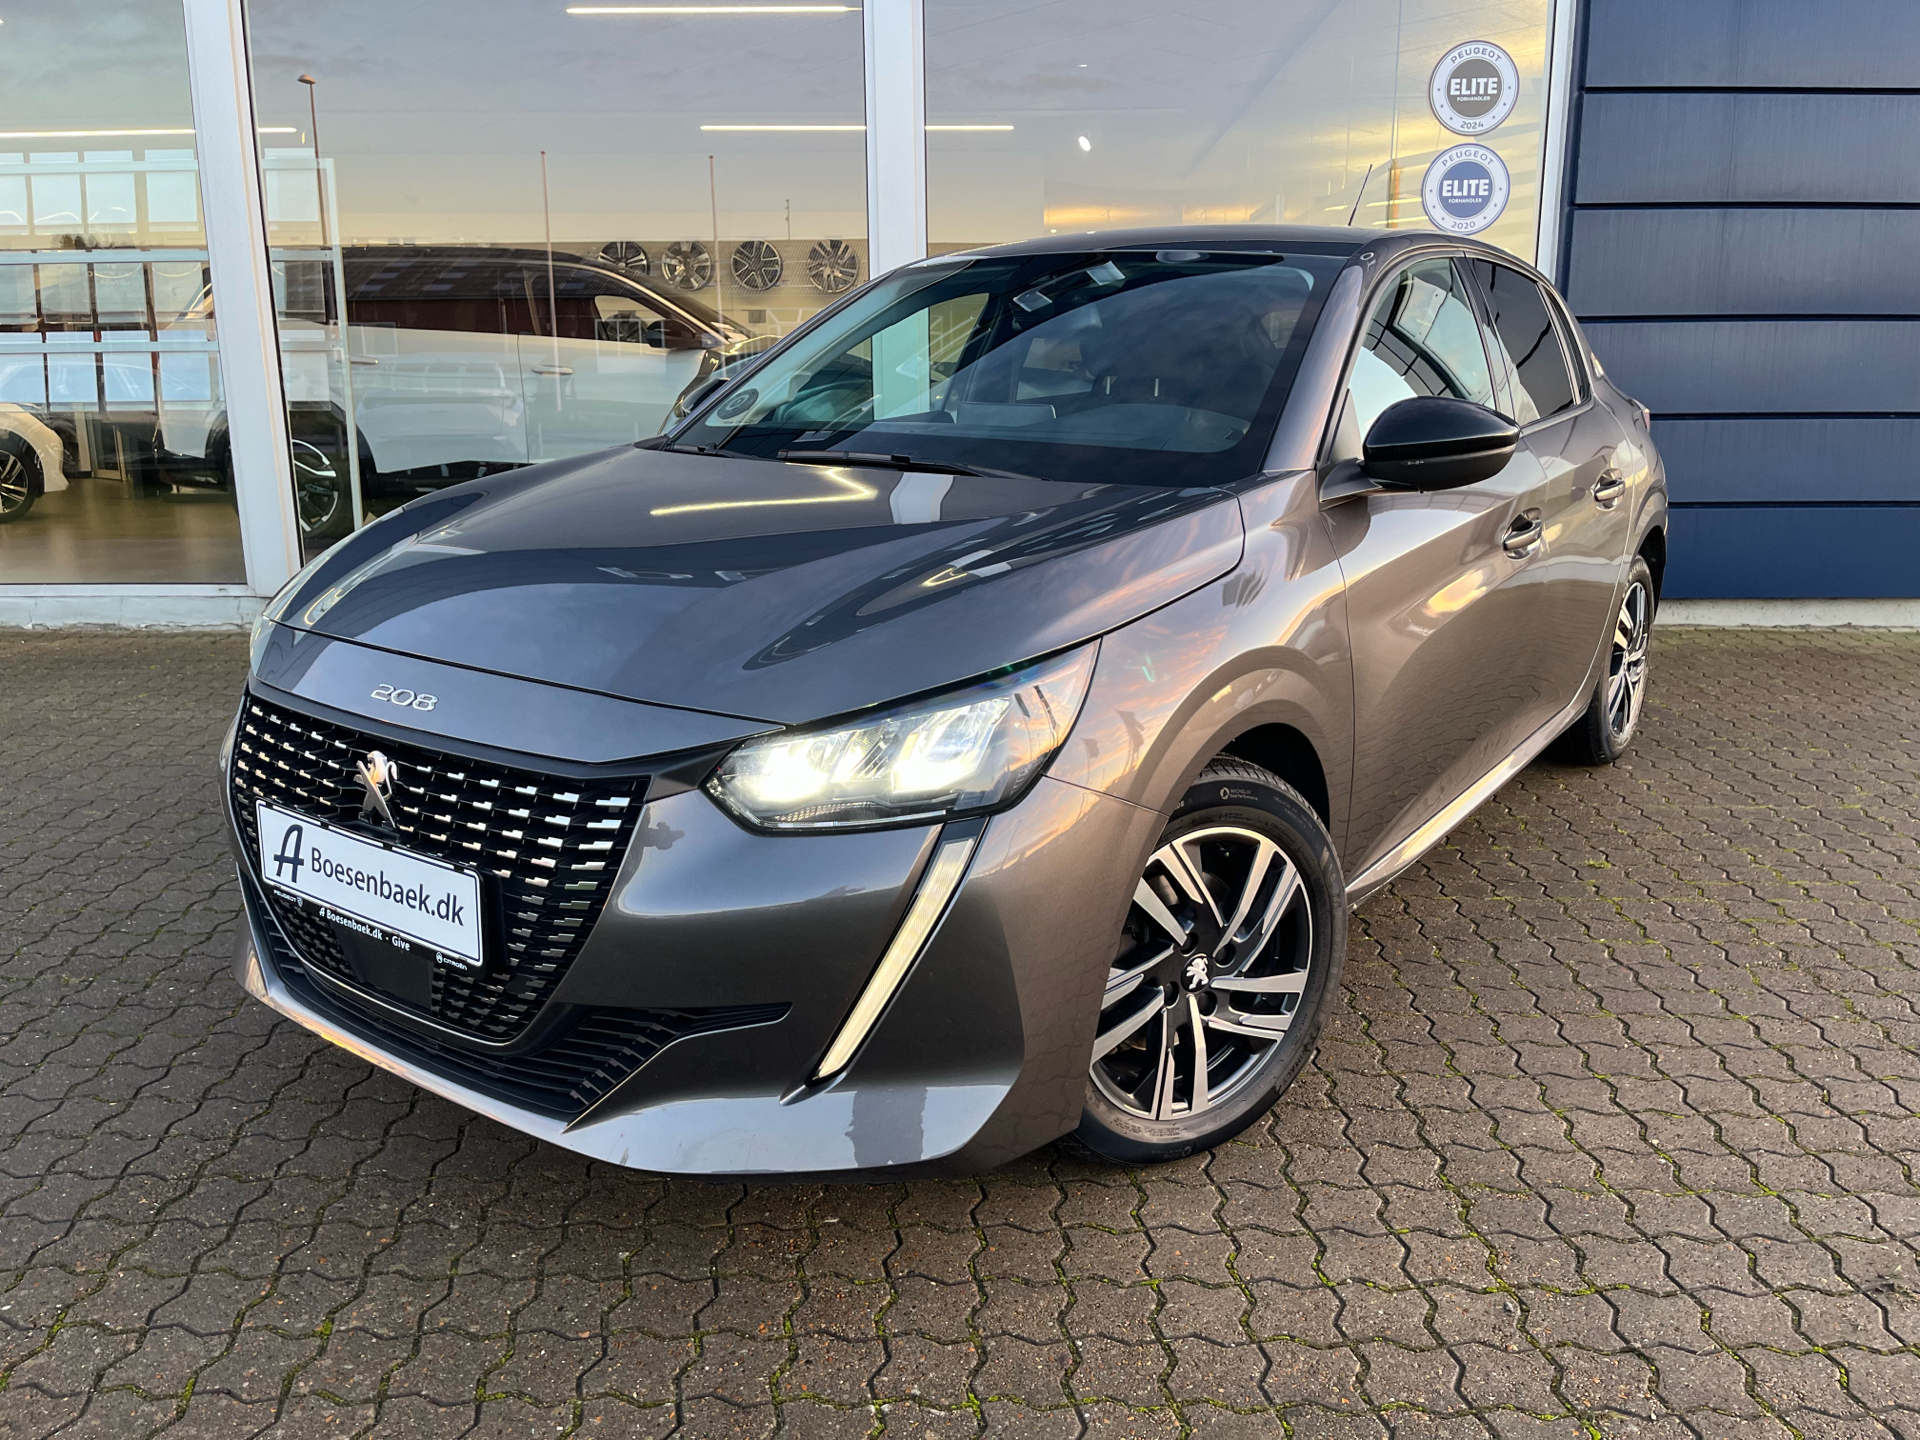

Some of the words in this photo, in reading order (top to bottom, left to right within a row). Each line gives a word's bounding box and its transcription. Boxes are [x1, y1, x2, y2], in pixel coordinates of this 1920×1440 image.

[1450, 47, 1502, 64] PEUGEOT
[1450, 77, 1498, 95] ELITE
[1460, 121, 1484, 129] 2024
[1441, 150, 1494, 167] PEUGEOT
[1442, 179, 1489, 197] ELITE
[1451, 221, 1476, 229] 2020
[370, 683, 438, 711] 208
[311, 847, 464, 926] Boesenbaek.dk
[326, 909, 382, 940] Boesenbaek.dk
[391, 936, 410, 951] Give
